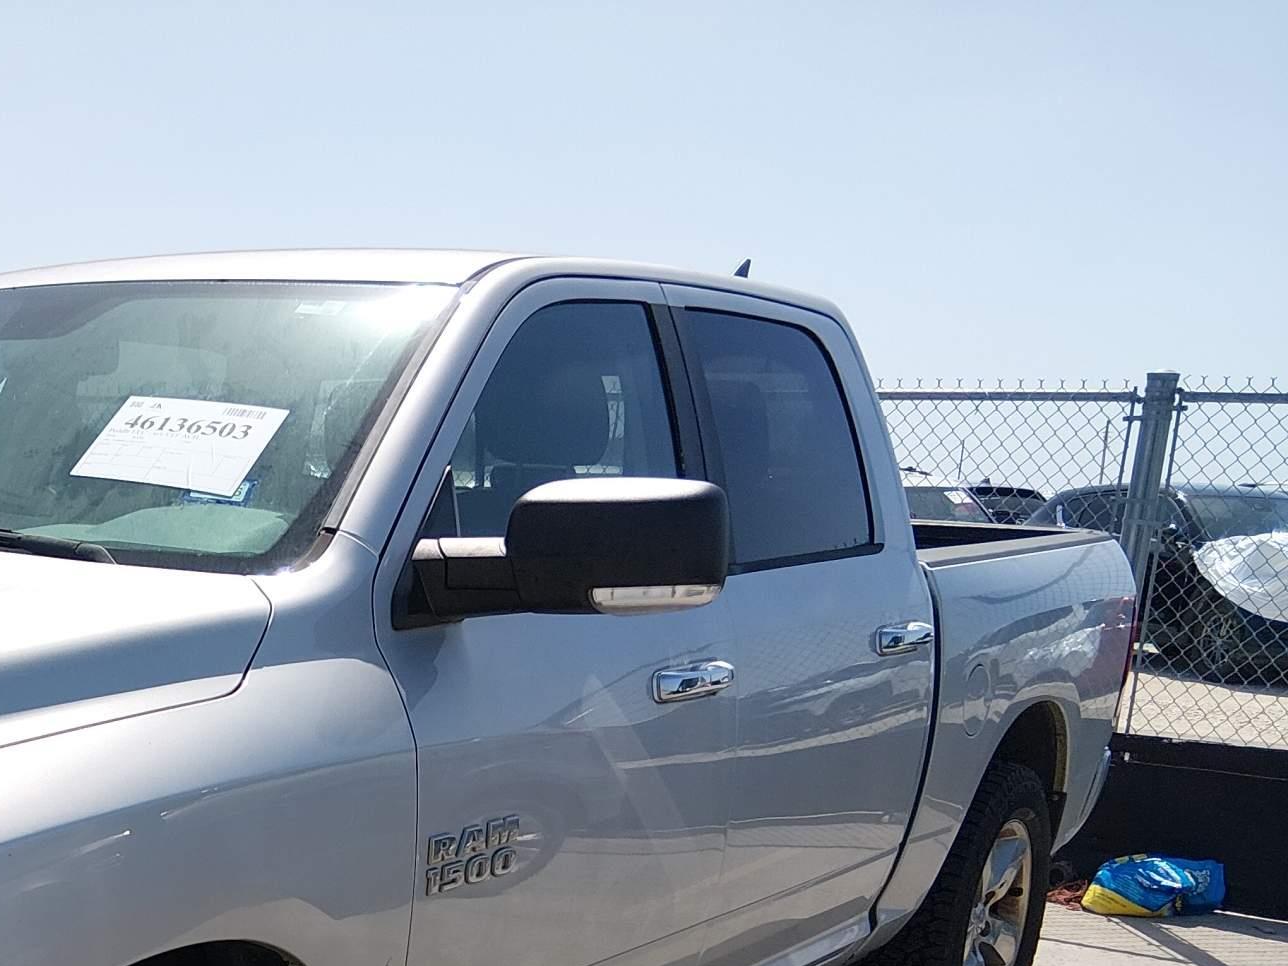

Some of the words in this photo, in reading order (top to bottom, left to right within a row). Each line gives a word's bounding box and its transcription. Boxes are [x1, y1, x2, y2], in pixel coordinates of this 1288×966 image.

[124, 414, 253, 440] 46136503
[427, 814, 520, 865] RAM
[425, 846, 517, 896] 1500
